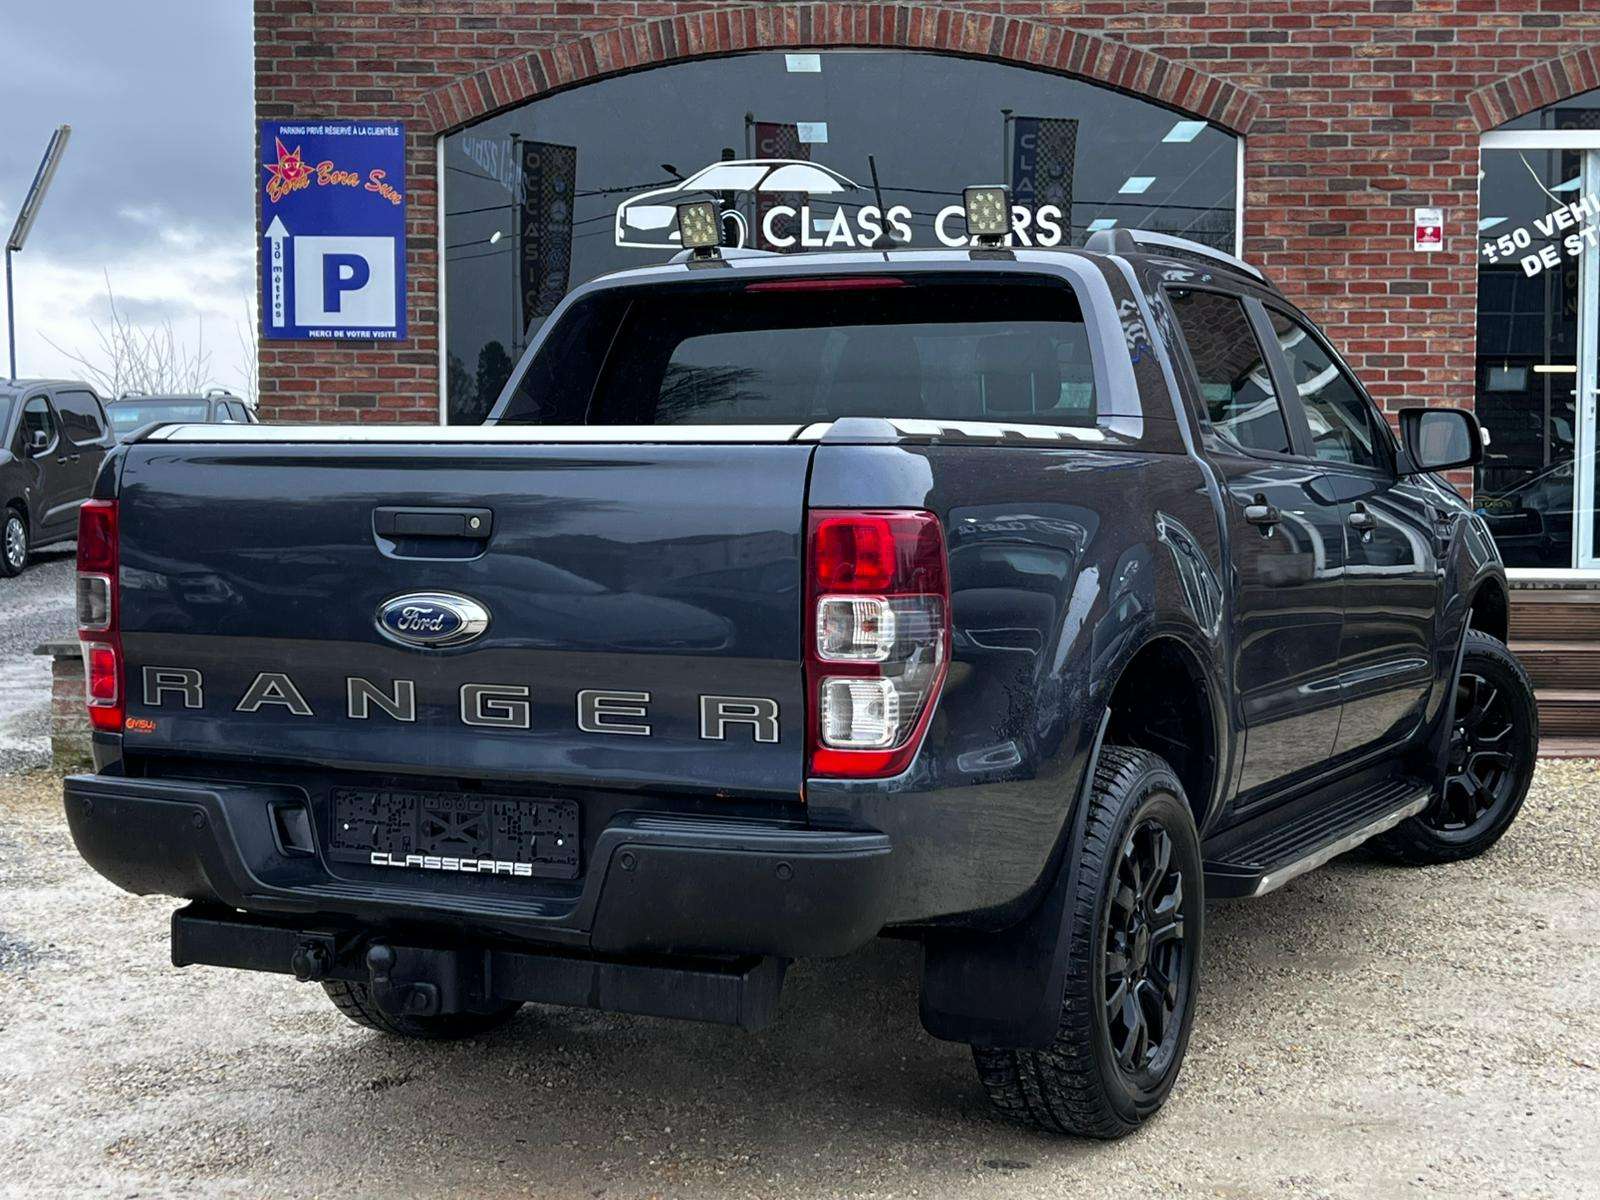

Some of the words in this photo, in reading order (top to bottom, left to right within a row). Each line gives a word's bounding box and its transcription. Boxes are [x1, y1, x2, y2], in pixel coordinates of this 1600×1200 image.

[280, 126, 305, 135] PARKING
[306, 126, 323, 135] PRIVÉ
[325, 125, 351, 135] RÉSERVÉ
[359, 126, 367, 135] LA
[367, 126, 399, 136] CLIENTÈLE
[266, 174, 310, 203] Bora
[316, 160, 360, 187] Bora
[365, 169, 402, 205] Sun
[762, 204, 913, 247] CLASS
[934, 204, 1063, 247] CRS
[274, 241, 281, 259] 30
[1520, 244, 1561, 278] DE
[1564, 224, 1600, 256] ST
[322, 253, 370, 313] P
[309, 330, 332, 338] MERCI
[334, 330, 344, 338] DE
[346, 330, 371, 338] VOTRE
[372, 330, 397, 338] VISITE
[398, 606, 444, 631] Ford
[142, 665, 779, 743] RANGER
[370, 852, 533, 877] CLASSCARS
